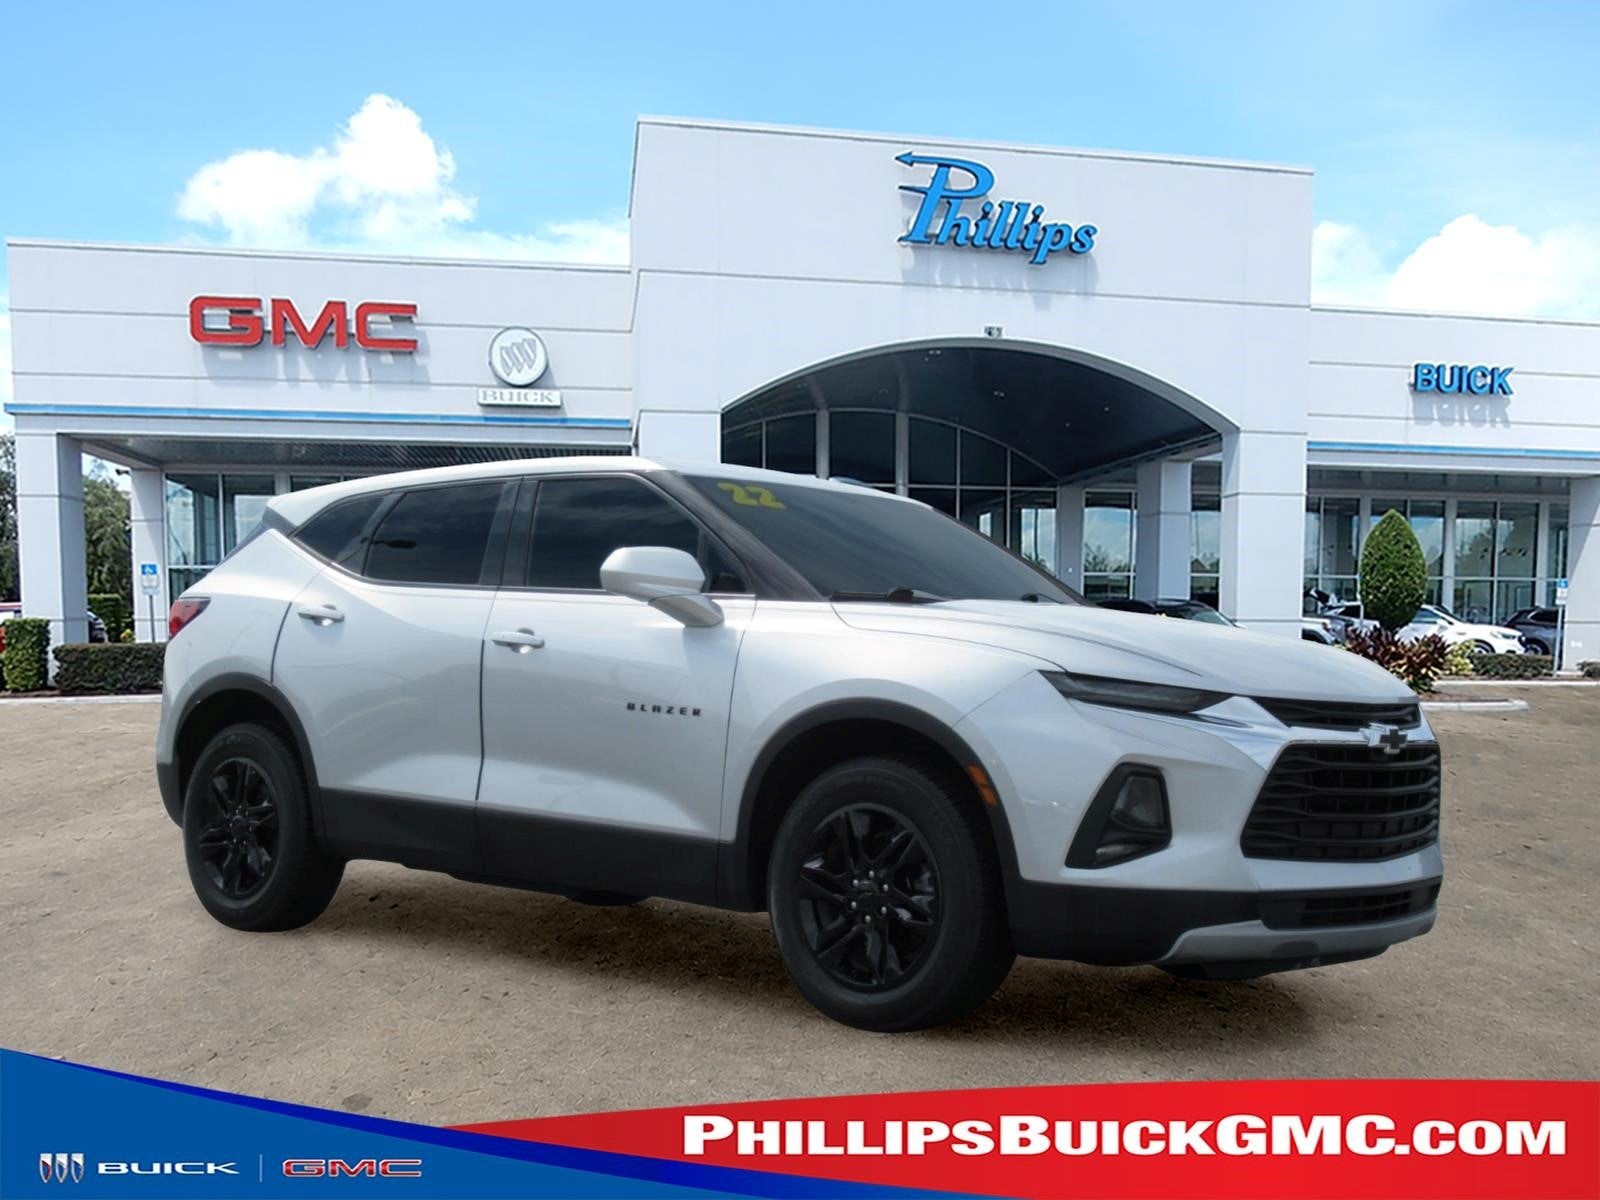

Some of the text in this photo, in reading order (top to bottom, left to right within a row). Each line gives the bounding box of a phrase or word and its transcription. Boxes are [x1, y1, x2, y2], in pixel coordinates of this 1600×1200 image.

[895, 151, 1098, 265] Phillips
[189, 296, 418, 353] GMC
[1413, 363, 1513, 396] BUICK
[481, 389, 554, 404] BUICK
[717, 482, 786, 509] 22
[626, 702, 702, 717] BLAZER
